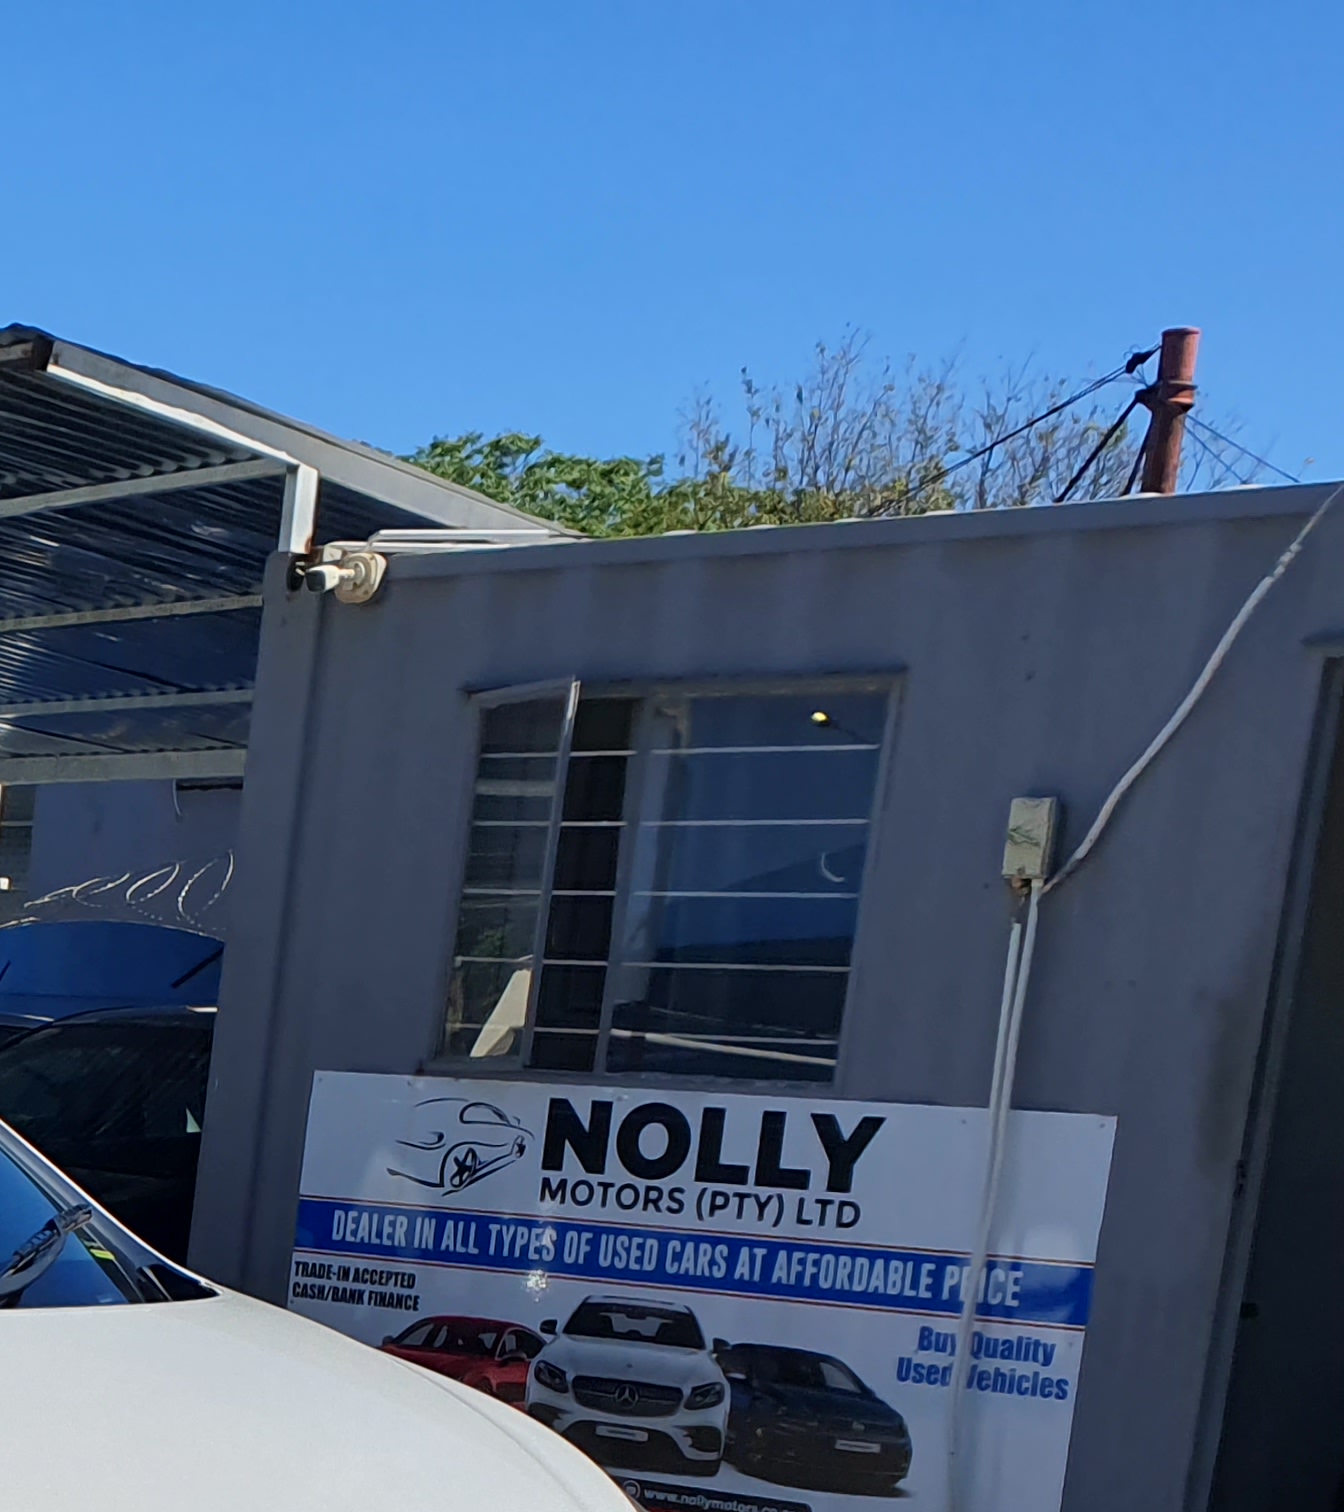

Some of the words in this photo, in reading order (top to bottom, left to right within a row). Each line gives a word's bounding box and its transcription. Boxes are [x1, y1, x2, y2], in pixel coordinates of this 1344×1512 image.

[541, 1097, 886, 1194] NOLLY
[539, 1177, 685, 1215] MOTORS
[696, 1187, 784, 1228] (PTY)
[796, 1198, 861, 1228] LTD
[294, 1260, 351, 1283] TRADE-IN
[352, 1267, 417, 1290] ACCEPTED
[332, 1210, 406, 1248] DEALER
[413, 1216, 436, 1251] IN
[440, 1219, 480, 1255] ALL
[488, 1223, 558, 1262] TYPES
[563, 1230, 594, 1266] OF
[598, 1234, 658, 1271] USED
[665, 1240, 729, 1279] CARS
[734, 1246, 768, 1283] AT
[771, 1250, 936, 1299] AFFORDABLE
[292, 1281, 366, 1306] CASH/BANK
[367, 1289, 421, 1312] FINANCE
[971, 1331, 1057, 1367] Quality
